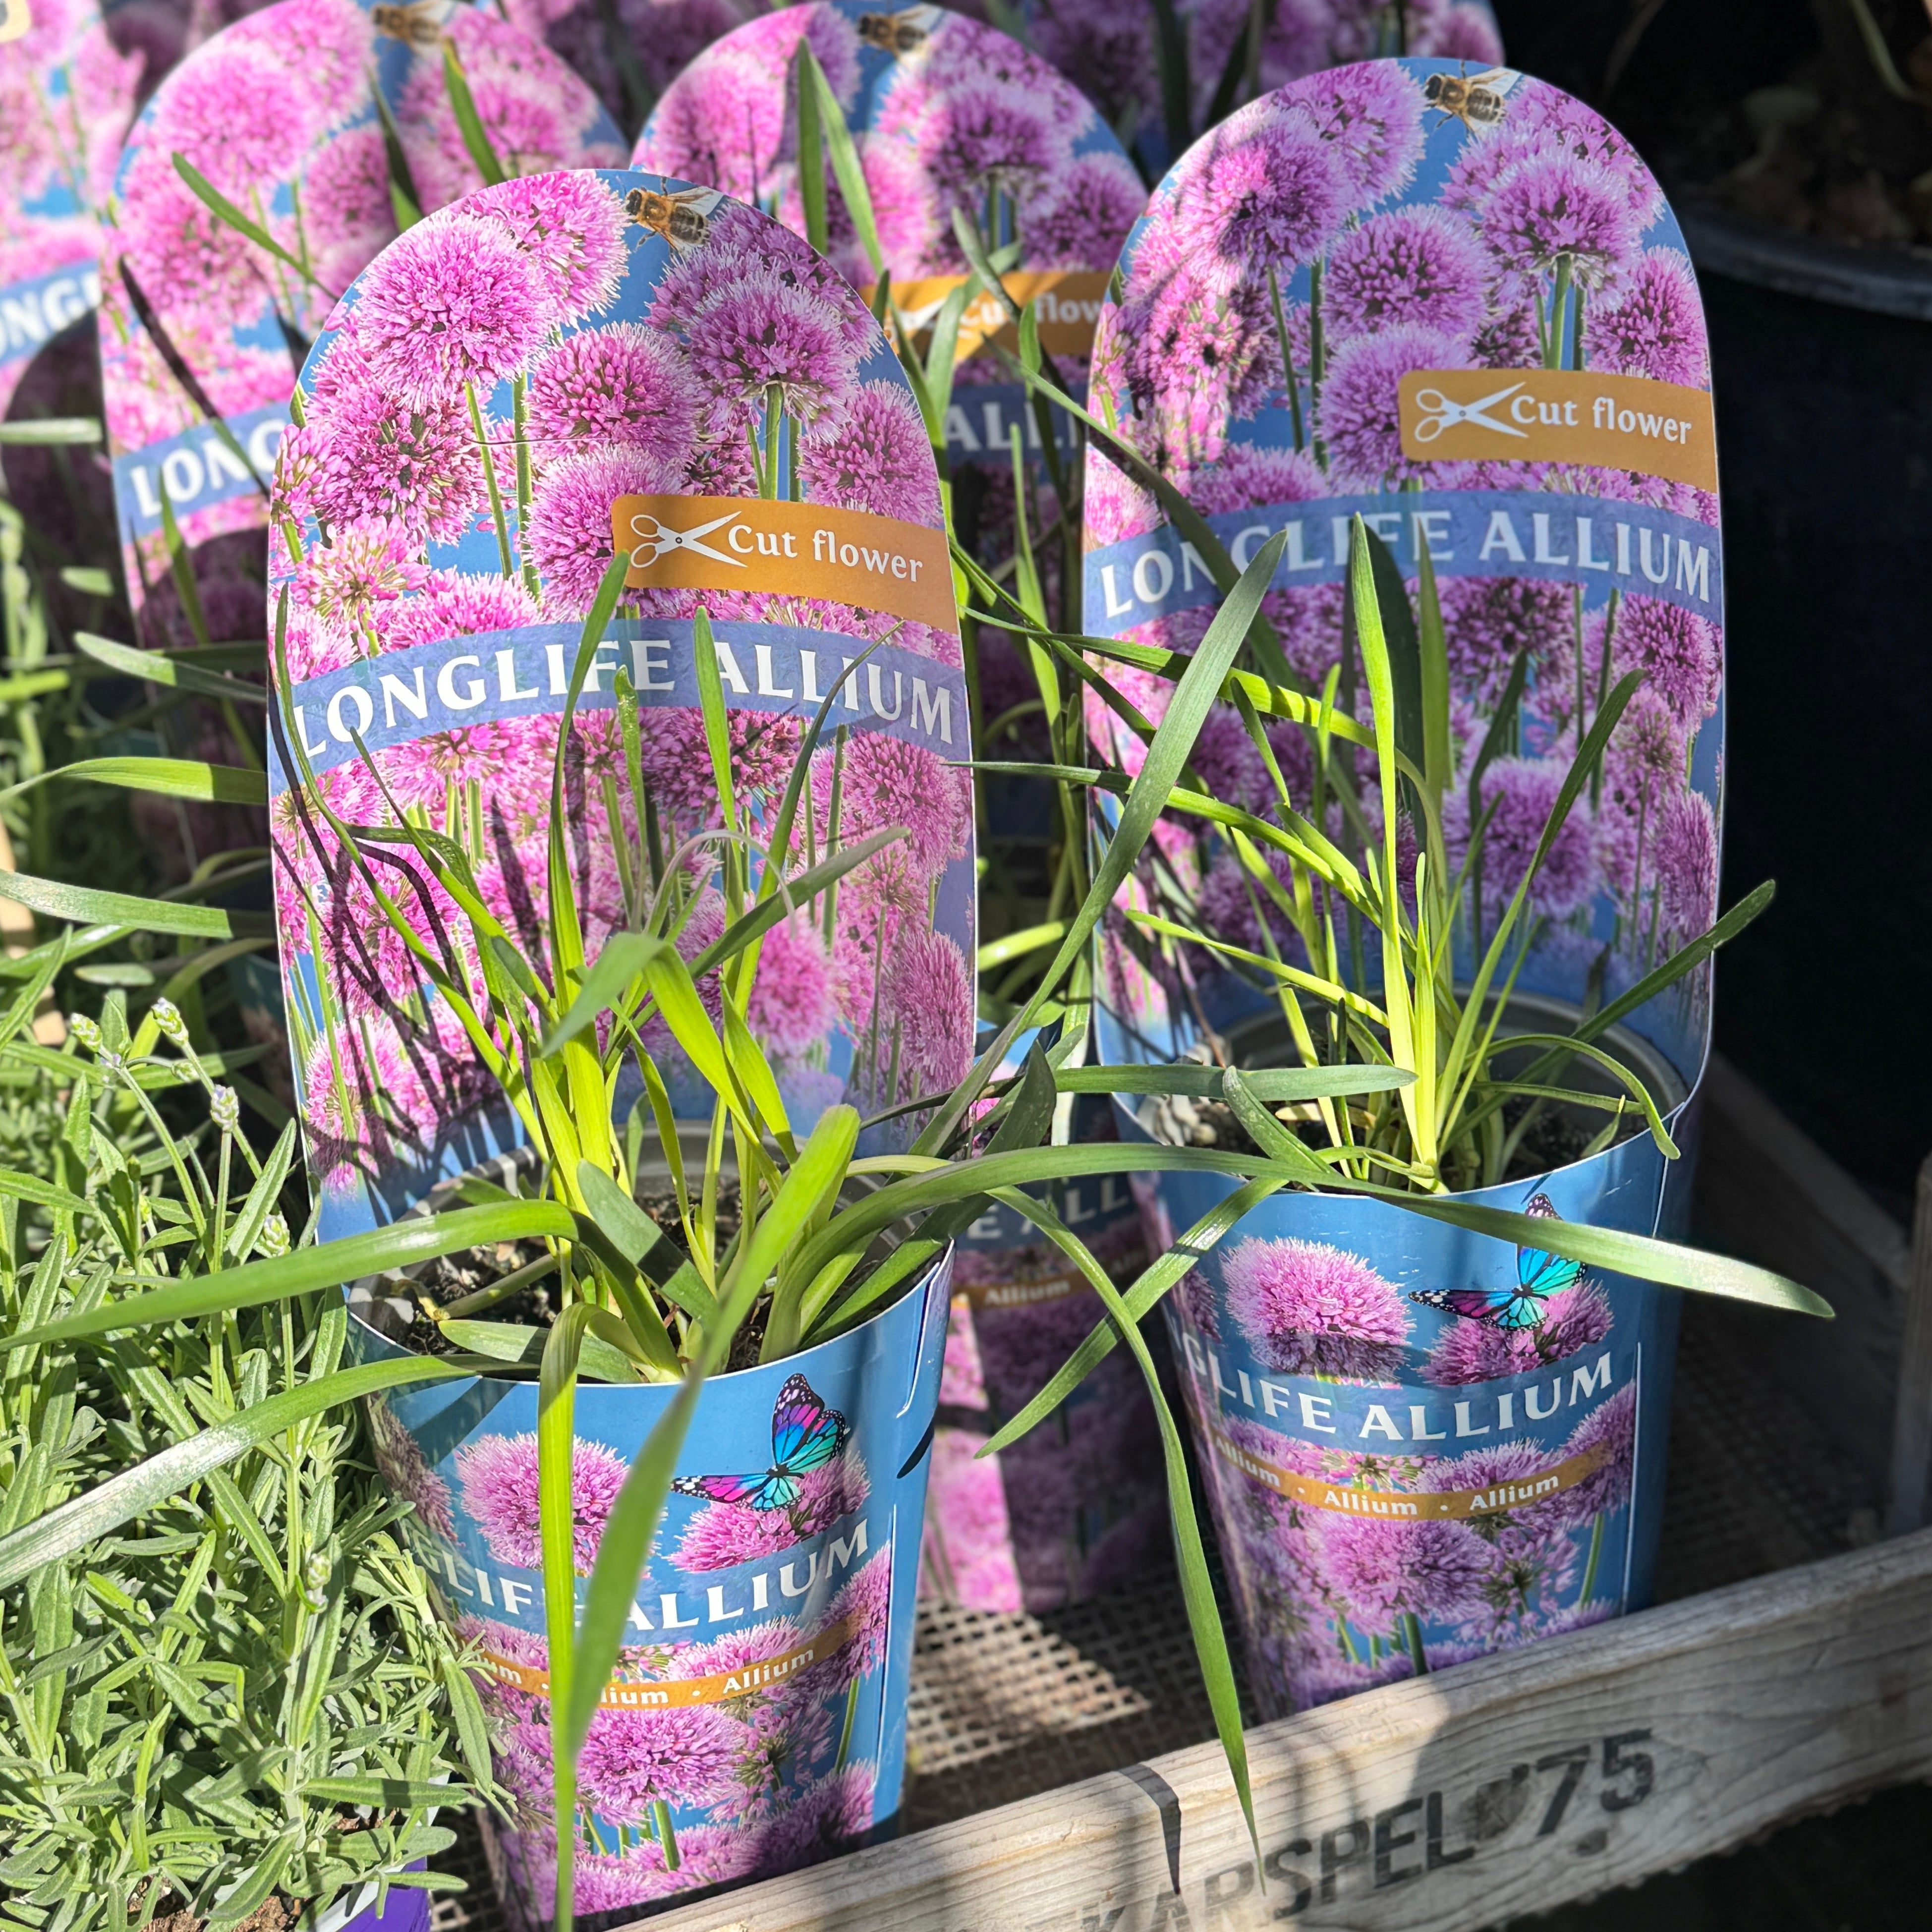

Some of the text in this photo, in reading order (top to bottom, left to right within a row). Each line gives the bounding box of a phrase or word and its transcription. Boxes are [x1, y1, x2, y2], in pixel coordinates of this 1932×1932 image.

[0, 273, 102, 358] NG
[1510, 396, 1692, 445] Cut flower
[728, 524, 923, 582] Cut flower
[1478, 511, 1709, 603] ALLIUM
[293, 639, 953, 758] LONGLIFE ALLIUM
[983, 1279, 1071, 1306] Allium
[1359, 1351, 1613, 1440] ALLIUM
[1215, 1436, 1559, 1516] Allium Allium Allium
[723, 1649, 814, 1694] Allium
